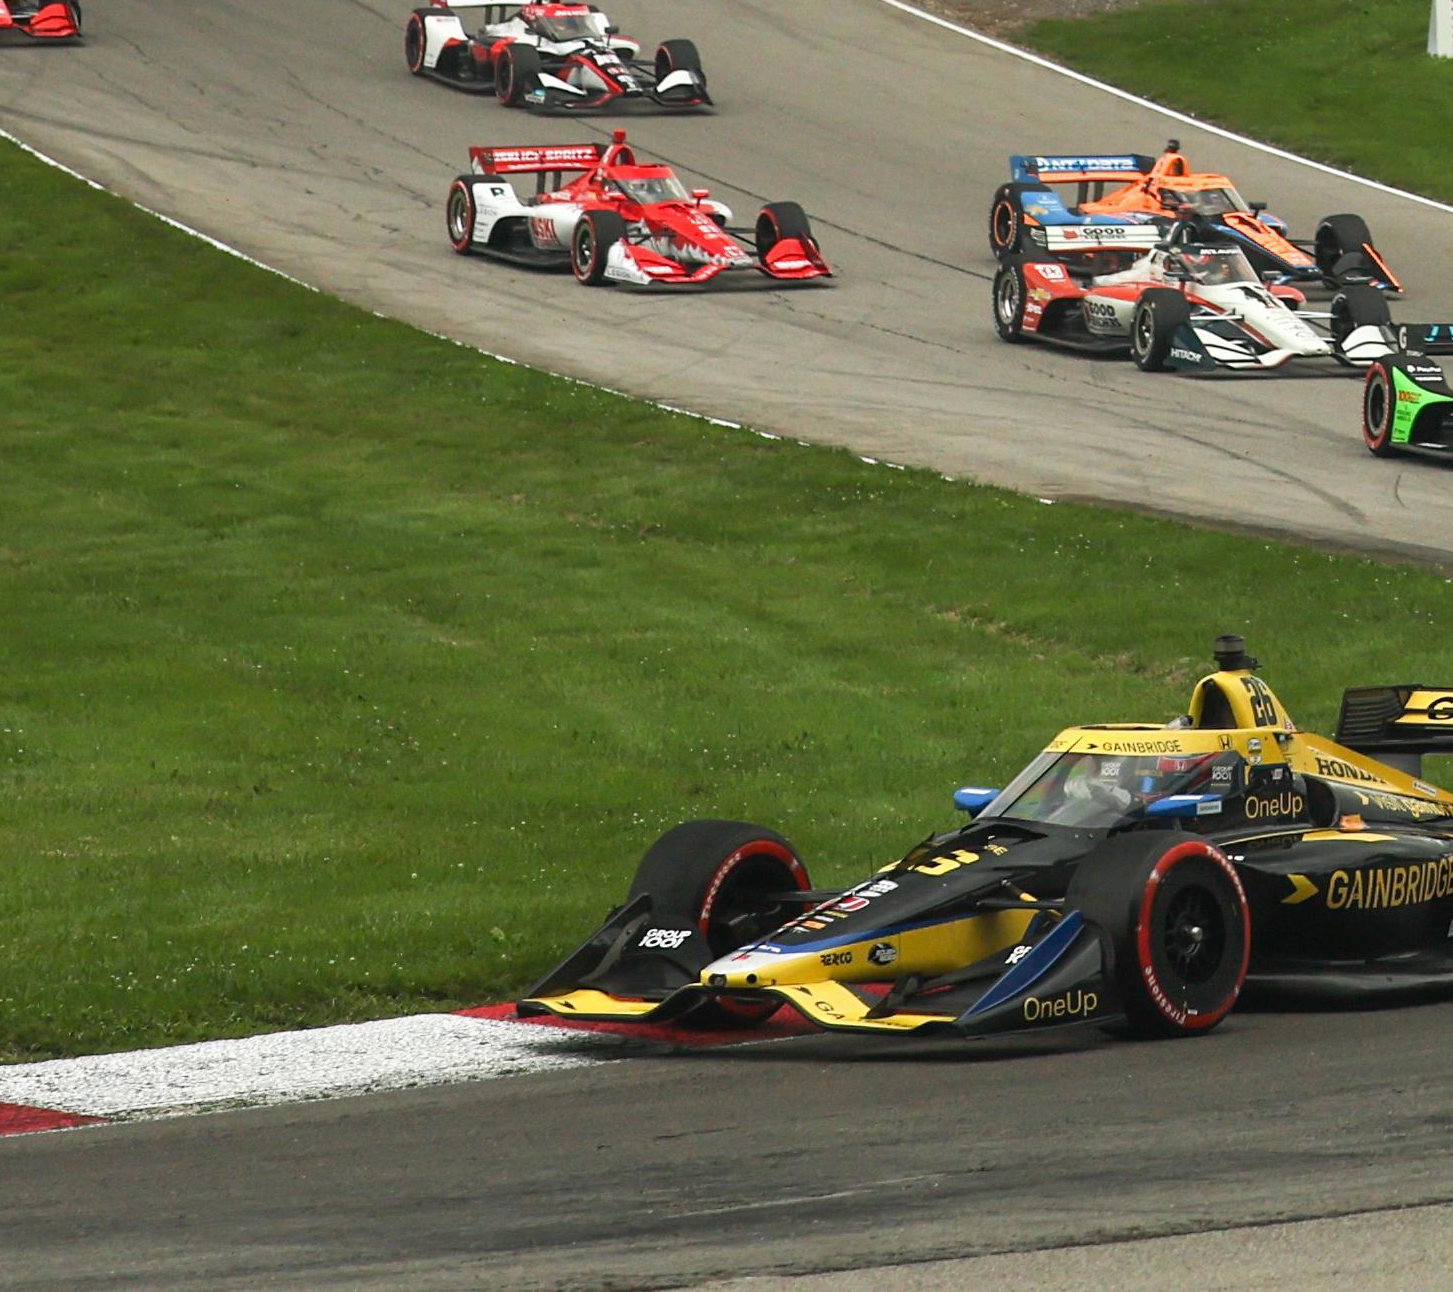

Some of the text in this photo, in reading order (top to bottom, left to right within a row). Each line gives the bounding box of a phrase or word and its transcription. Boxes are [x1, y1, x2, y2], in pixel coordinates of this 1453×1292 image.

[545, 149, 593, 161] SPRITZ
[1171, 347, 1201, 362] HITACHI
[1102, 739, 1183, 753] GAINBRIDGE
[1245, 791, 1303, 818] OneUp
[646, 928, 692, 940] GROUP
[638, 936, 684, 949] 1001
[1145, 965, 1187, 1026] Firestone
[1023, 989, 1098, 1022] OneUp
